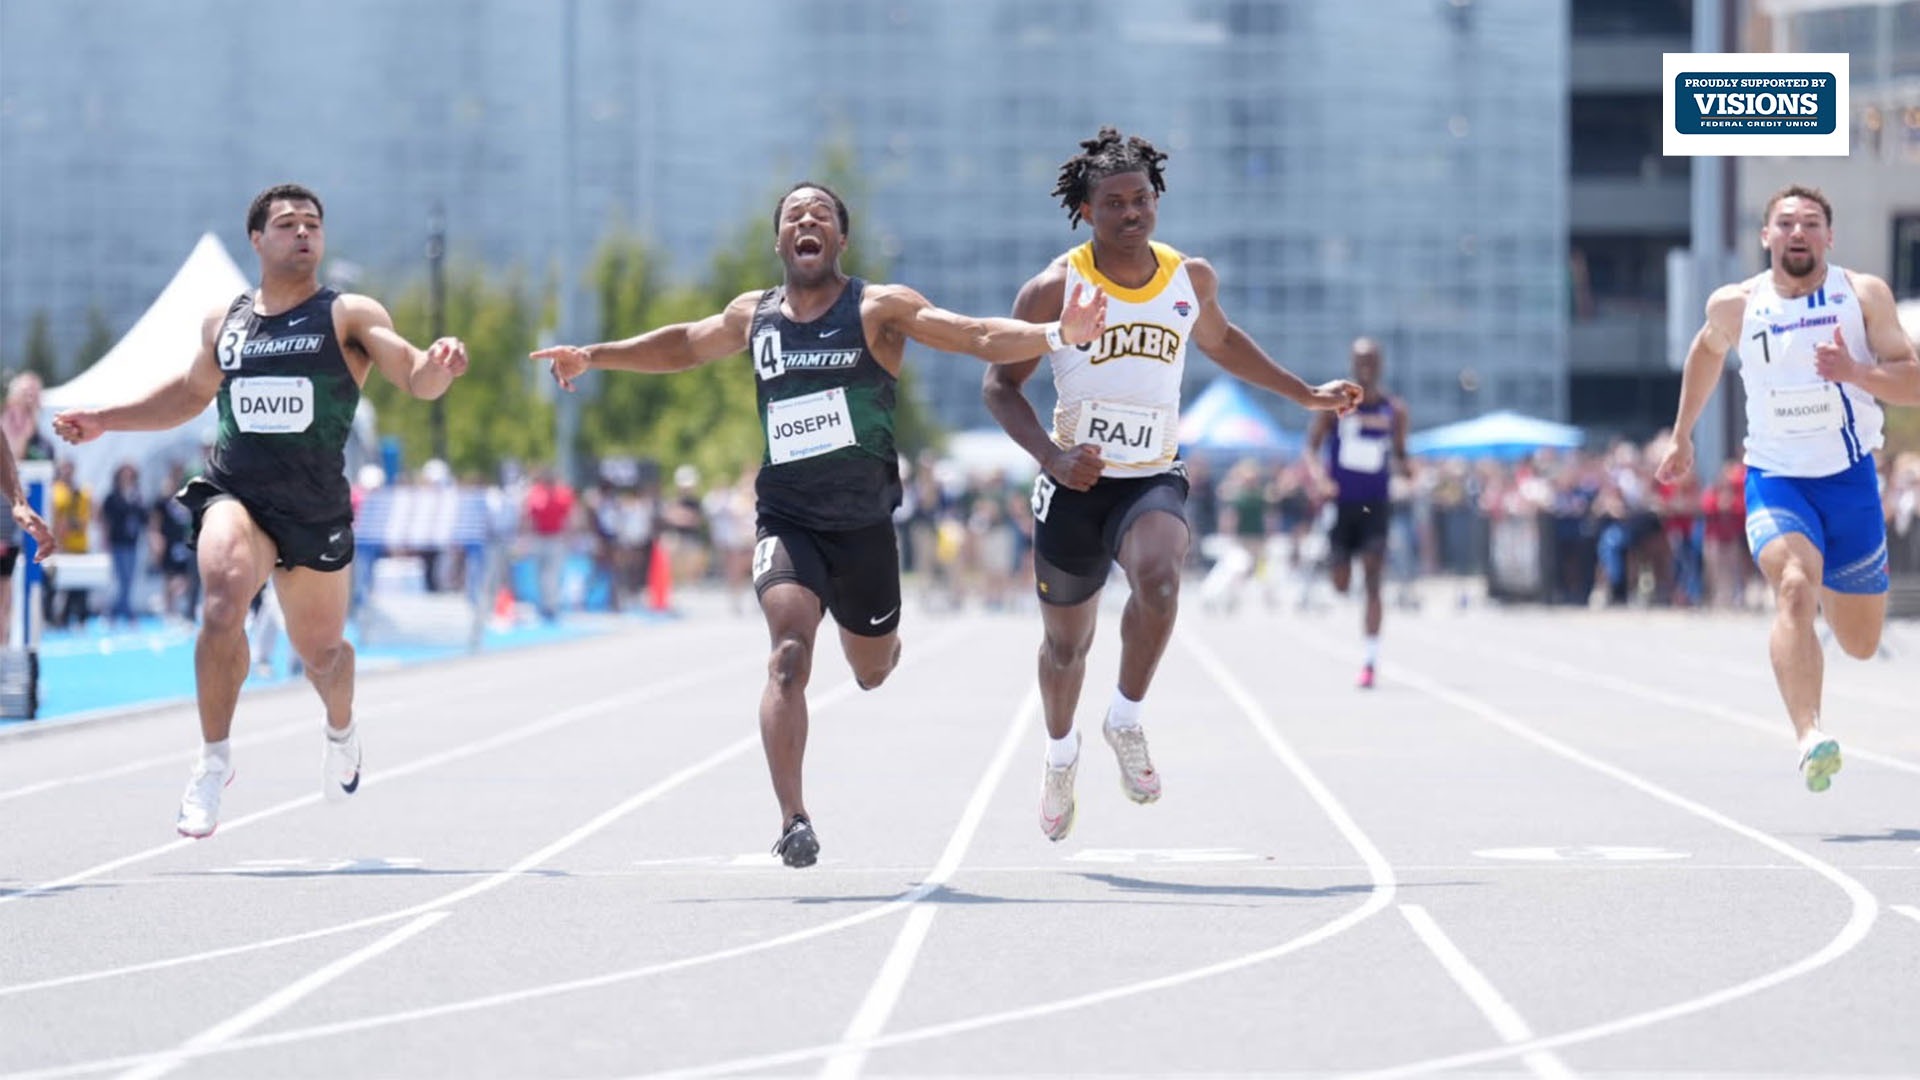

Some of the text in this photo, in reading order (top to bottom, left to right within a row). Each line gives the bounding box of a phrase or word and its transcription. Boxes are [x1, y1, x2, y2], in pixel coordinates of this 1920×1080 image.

[224, 332, 239, 366] 3
[761, 336, 777, 373] 4
[1752, 330, 1770, 363] 7
[240, 396, 304, 414] DAVID
[773, 411, 841, 440] JOSEPH
[1088, 417, 1152, 448] RAJI
[1034, 480, 1050, 515] 5
